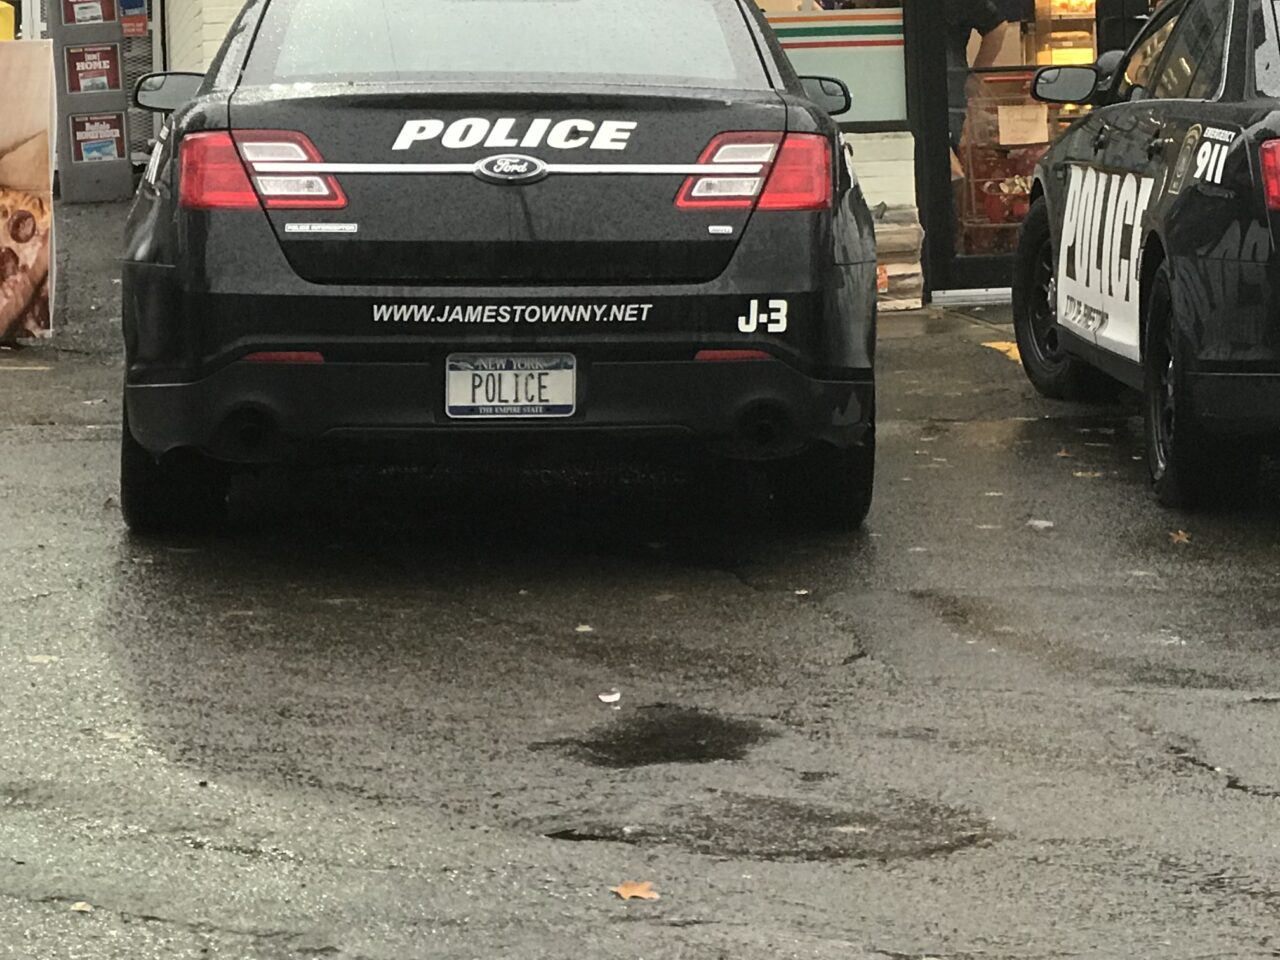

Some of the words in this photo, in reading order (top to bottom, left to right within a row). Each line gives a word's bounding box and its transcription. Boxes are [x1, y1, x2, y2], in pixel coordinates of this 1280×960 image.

[76, 60, 110, 71] HOME
[391, 117, 638, 151] POLICE
[1203, 126, 1236, 143] EMERGENCY
[493, 158, 528, 173] Ford
[1193, 141, 1229, 184] 911
[1060, 165, 1154, 302] POLICE
[372, 303, 652, 324] WWW.JAMESTOWNNY.NET
[737, 299, 788, 333] J-3
[478, 359, 507, 370] NEW
[511, 358, 545, 370] YORK
[471, 372, 550, 404] POLICE
[479, 406, 493, 414] THE
[495, 405, 521, 414] EMPIRE
[524, 405, 543, 413] STATE
